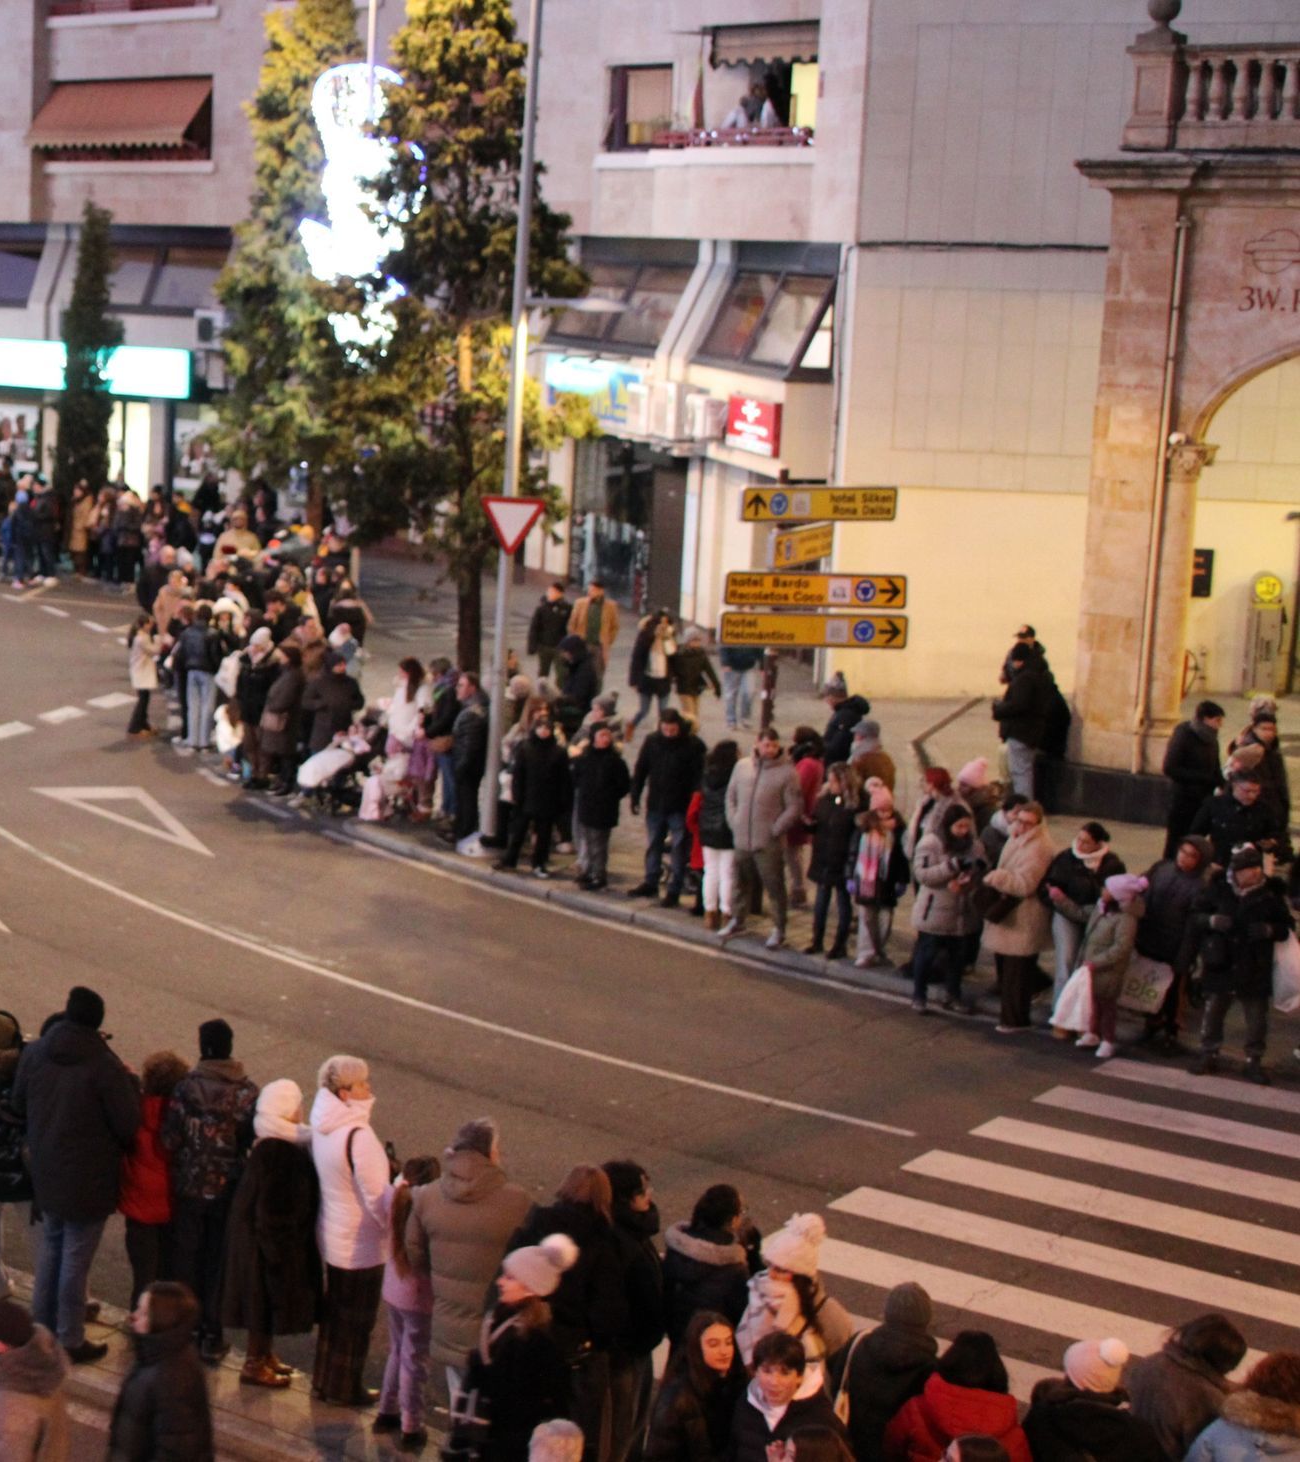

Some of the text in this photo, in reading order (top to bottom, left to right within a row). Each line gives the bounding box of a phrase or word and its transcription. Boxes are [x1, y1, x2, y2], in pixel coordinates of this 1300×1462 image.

[830, 492, 893, 505] hotel Silken
[730, 576, 810, 588] hotel Bardo
[729, 589, 825, 602] Recoletos Coco
[725, 617, 758, 628] hotel
